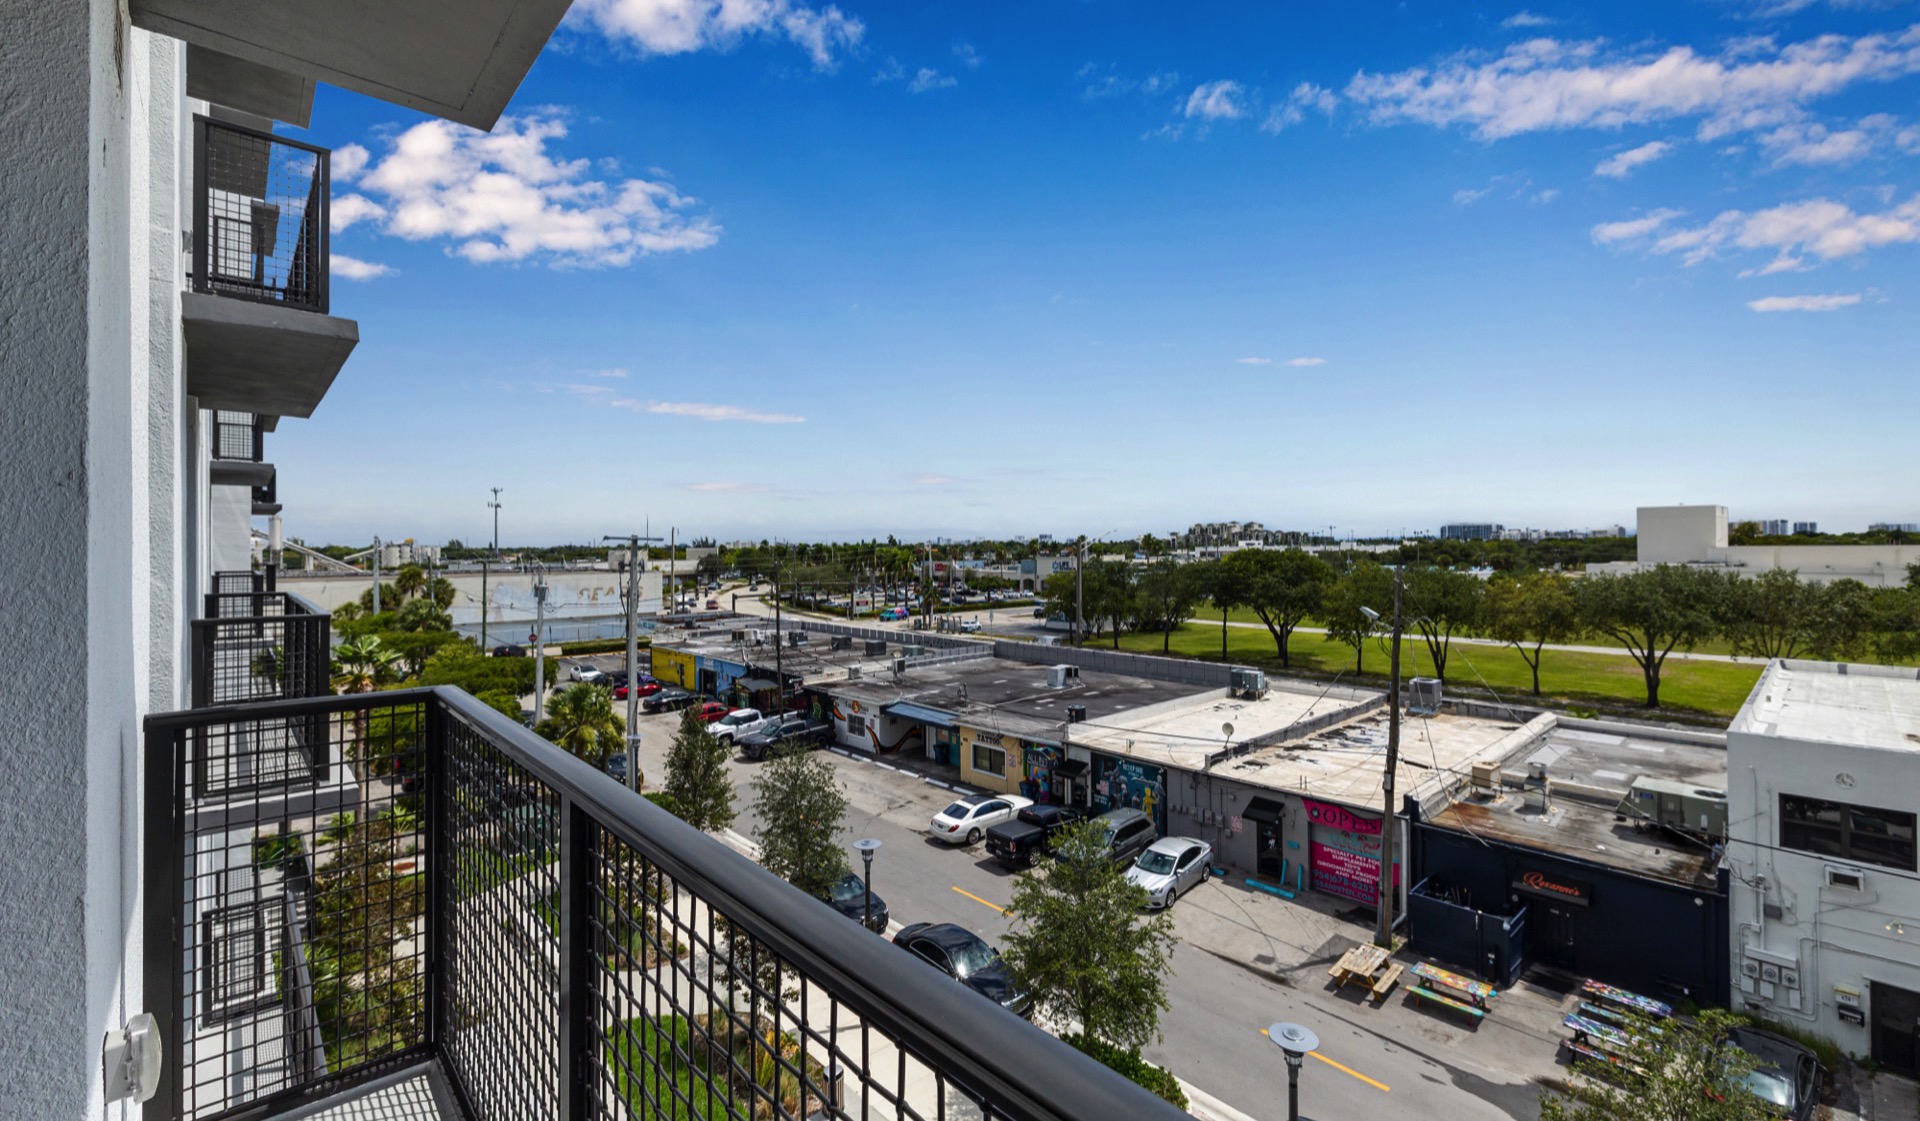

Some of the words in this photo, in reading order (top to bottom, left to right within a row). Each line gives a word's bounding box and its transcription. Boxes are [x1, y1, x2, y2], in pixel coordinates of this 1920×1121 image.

[1323, 808, 1377, 831] OPEN
[1323, 846, 1354, 858] SPECIALTY
[1355, 853, 1367, 862] PET
[1332, 854, 1376, 870] SUPPLEMENTS
[1317, 860, 1354, 874] GROOMING
[1355, 870, 1379, 881] PRODU
[1335, 870, 1350, 878] AND
[1344, 862, 1361, 871] TOYS
[1523, 871, 1581, 896] Roxanne's
